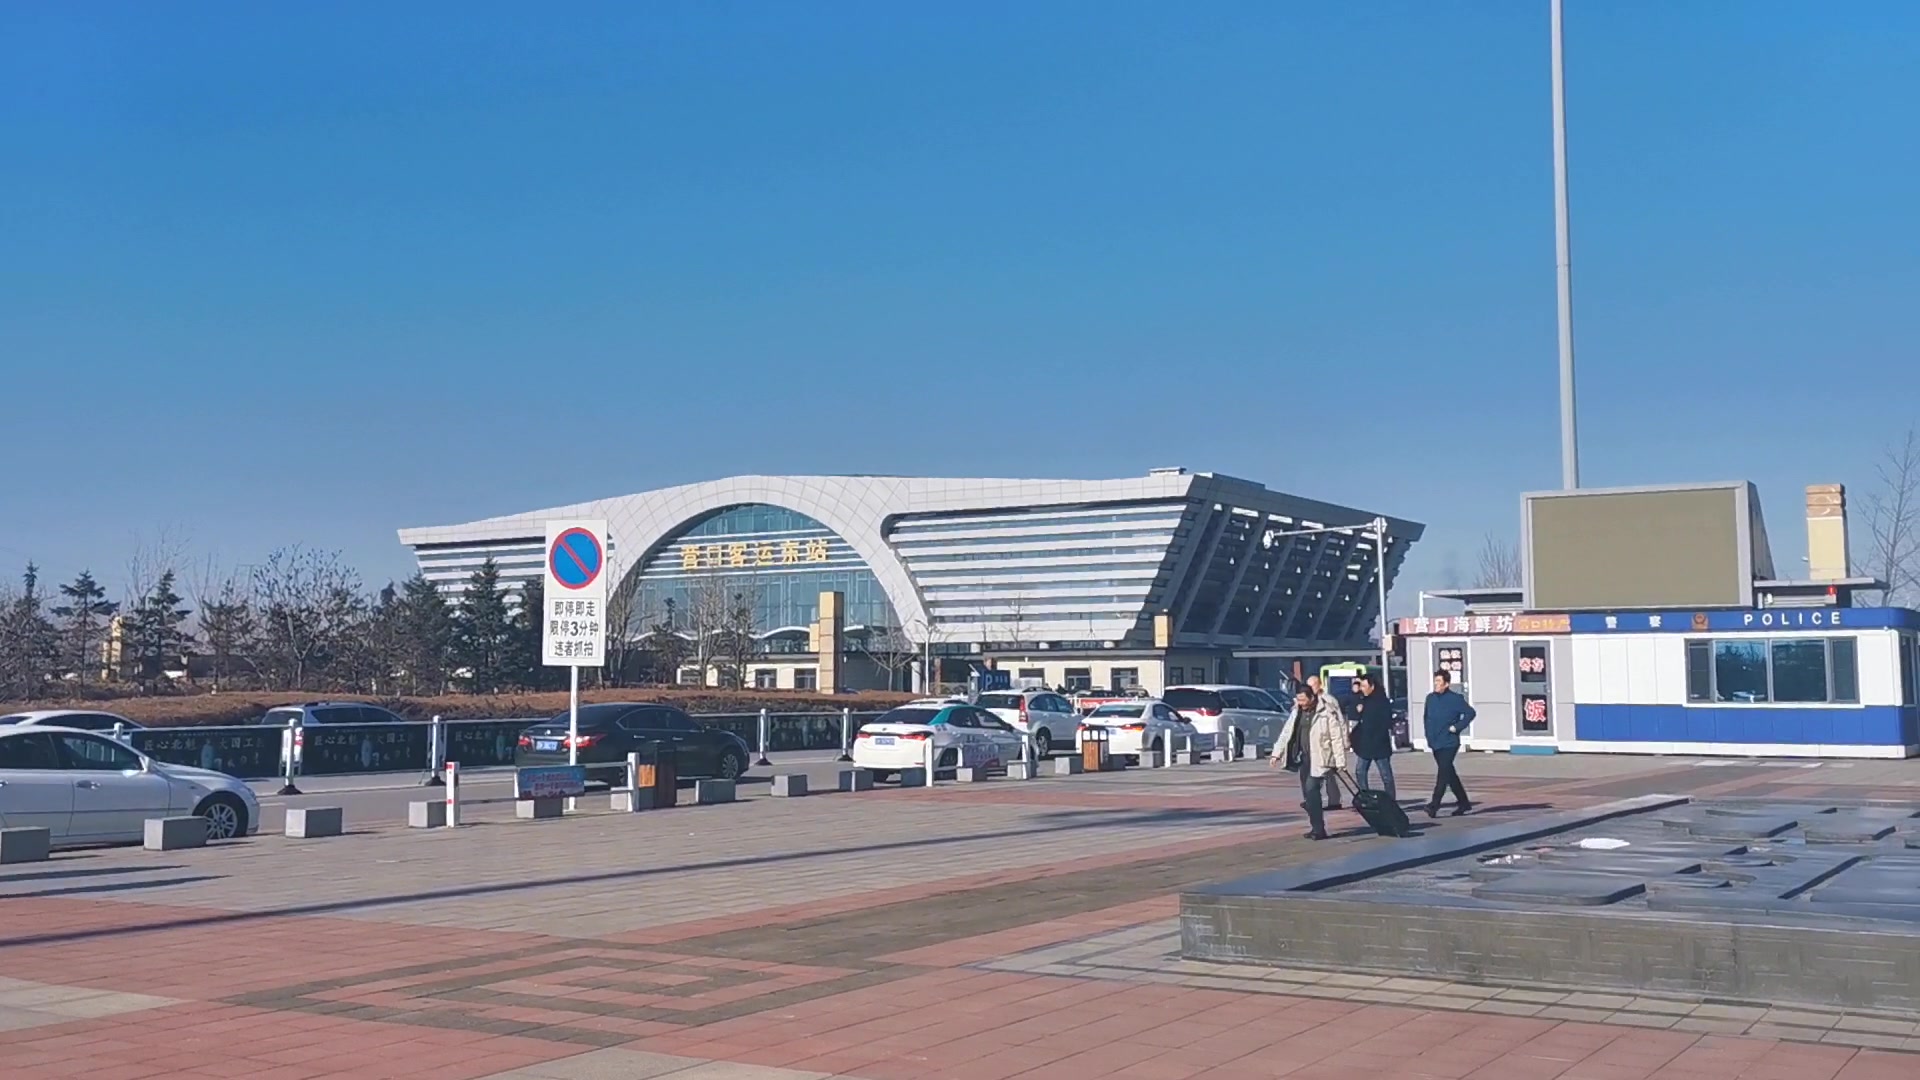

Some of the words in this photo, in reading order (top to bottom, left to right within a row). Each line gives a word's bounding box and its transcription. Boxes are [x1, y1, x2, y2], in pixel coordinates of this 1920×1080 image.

[680, 538, 828, 571] 营口客运东站
[554, 600, 596, 617] 即停即走
[1413, 614, 1515, 633] 营口海鲜坊
[1744, 612, 1841, 626] POLICE
[550, 620, 599, 637] 限停3分钟
[554, 640, 594, 657] 违者抓拍
